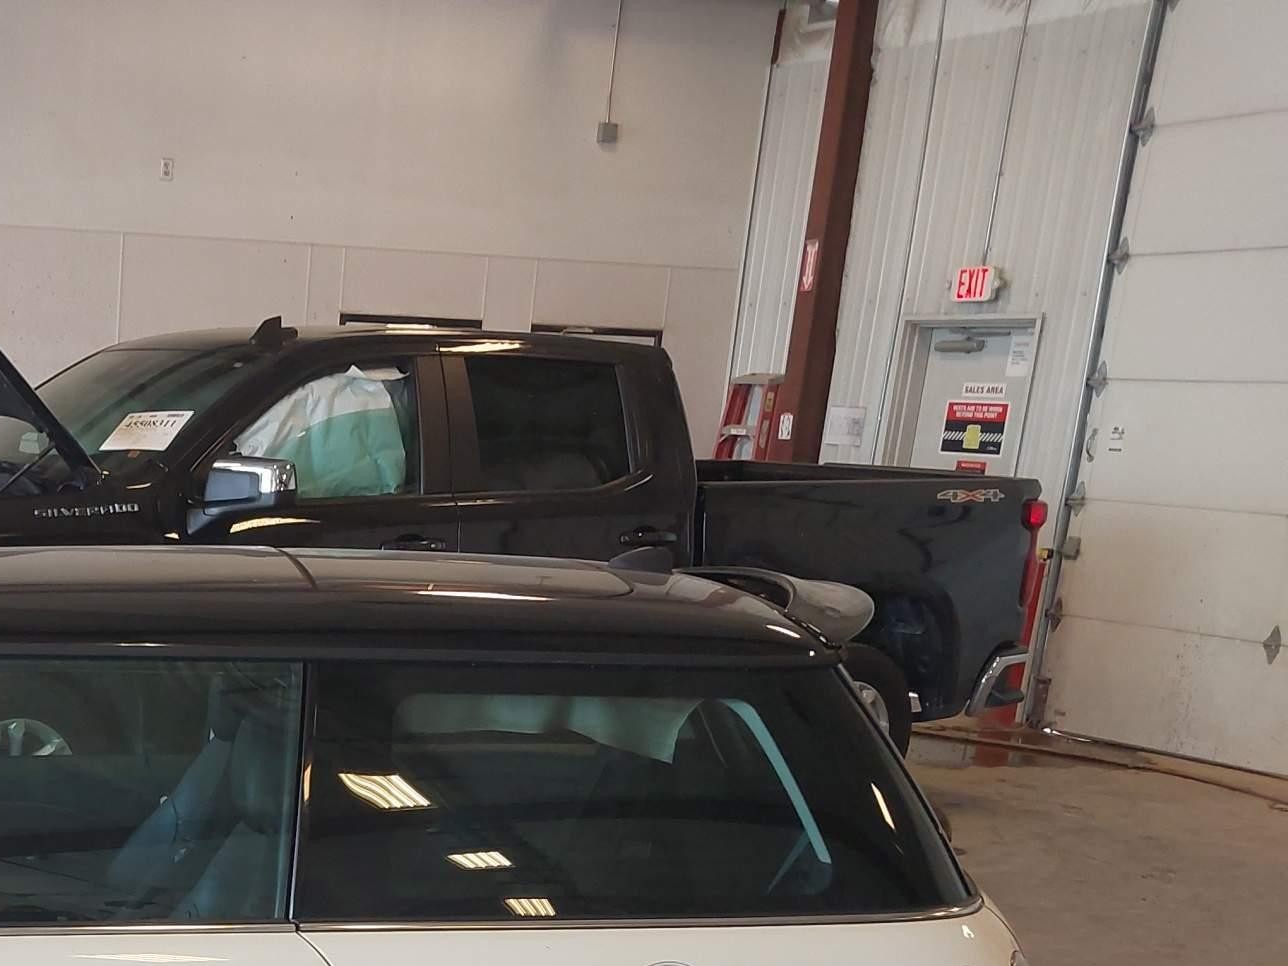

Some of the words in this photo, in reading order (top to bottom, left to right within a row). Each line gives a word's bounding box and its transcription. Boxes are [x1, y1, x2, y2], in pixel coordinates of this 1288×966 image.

[956, 268, 989, 299] EXIT
[964, 385, 984, 394] SALES
[986, 386, 1004, 395] AREA
[33, 503, 140, 519] SILVERADO
